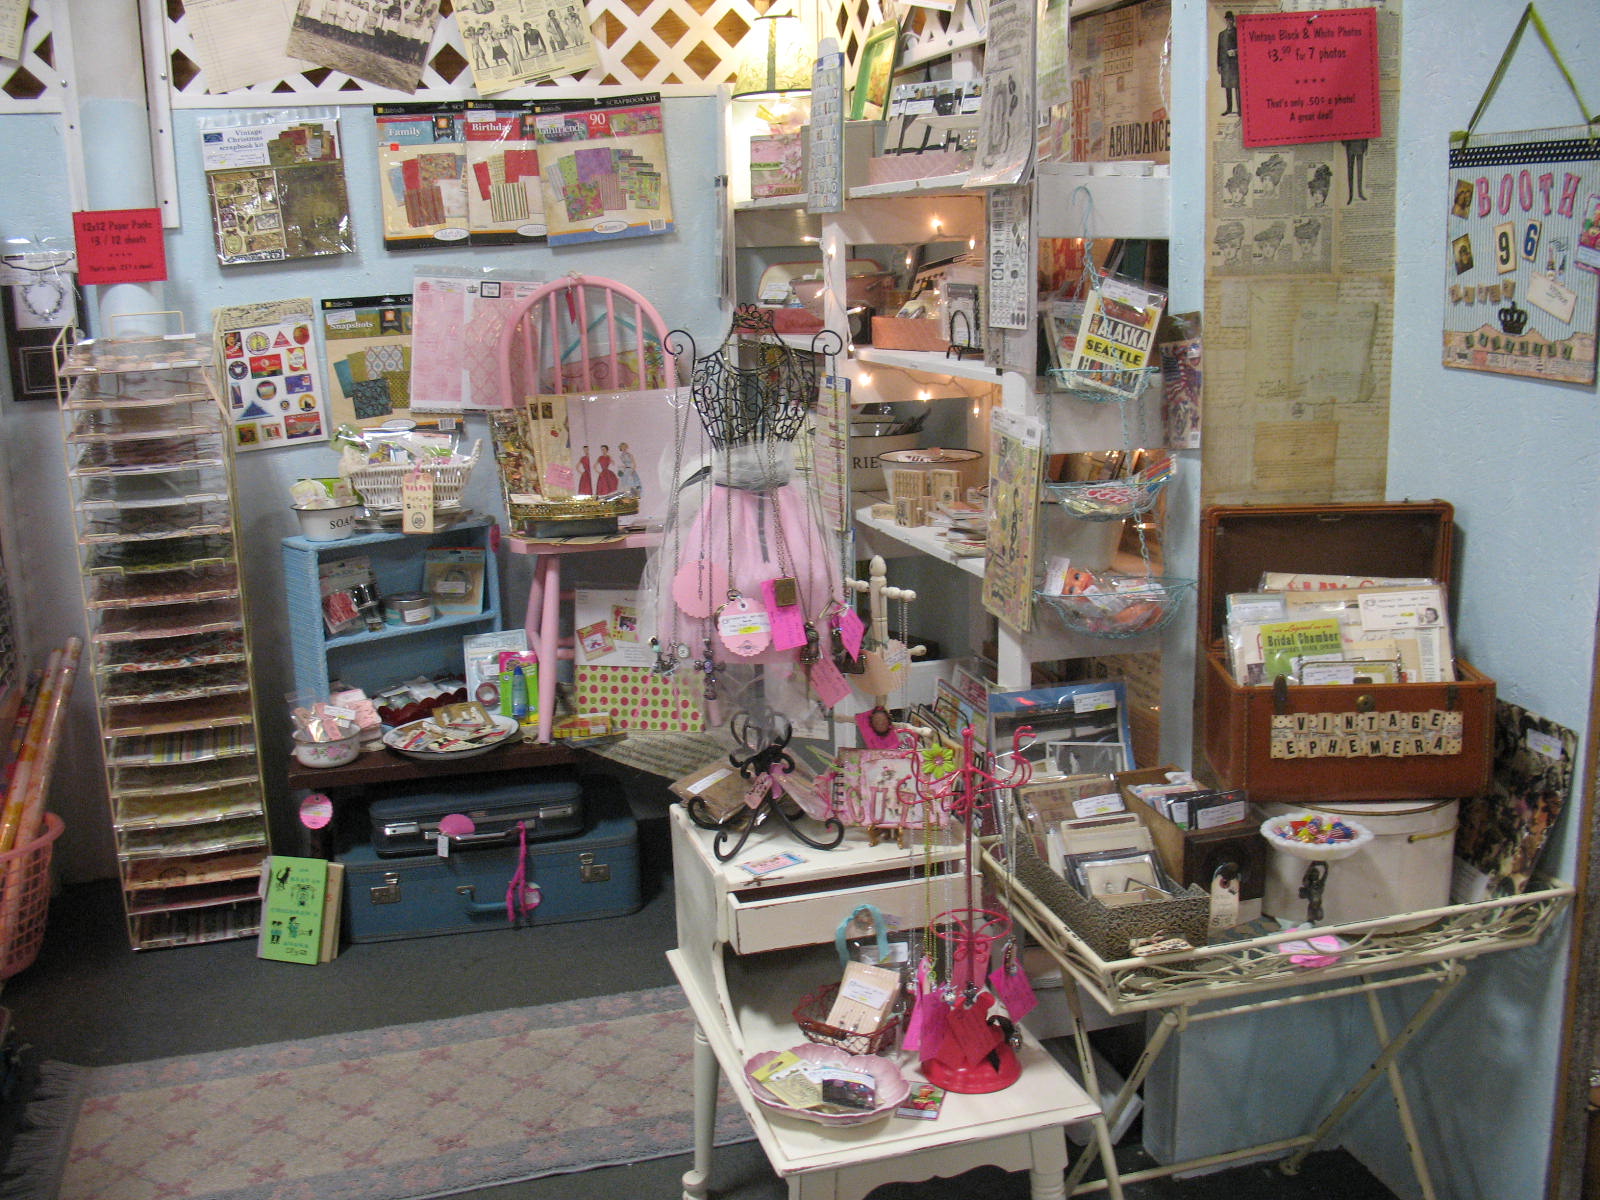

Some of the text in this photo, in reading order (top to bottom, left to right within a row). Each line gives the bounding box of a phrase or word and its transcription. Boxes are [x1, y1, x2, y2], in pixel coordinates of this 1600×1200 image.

[1249, 26, 1362, 44] Vintage Black & White Photos
[1296, 49, 1306, 61] for
[1309, 47, 1314, 59] 7
[1319, 48, 1347, 62] photos
[606, 95, 657, 105] SCRAPBOOK KIT
[1266, 97, 1288, 108] That's
[1290, 98, 1304, 109] only
[590, 112, 606, 125] 90
[1289, 111, 1296, 122] A
[1298, 112, 1316, 124] great
[235, 129, 263, 137] Vintage
[388, 127, 422, 137] Family
[472, 121, 512, 132] Birthday
[227, 135, 264, 143] Christmas
[1108, 119, 1170, 158] ABUNDANCE
[219, 141, 264, 152] scrapbook kit
[1475, 170, 1581, 218] BOOTH
[111, 235, 121, 245] 12
[328, 320, 374, 331] Snapshots
[1096, 318, 1151, 351] ALASKA
[1267, 631, 1338, 648] Bridal Chamber
[1297, 714, 1440, 730] VINTAGE
[1287, 737, 1443, 755] EPHEMERA
